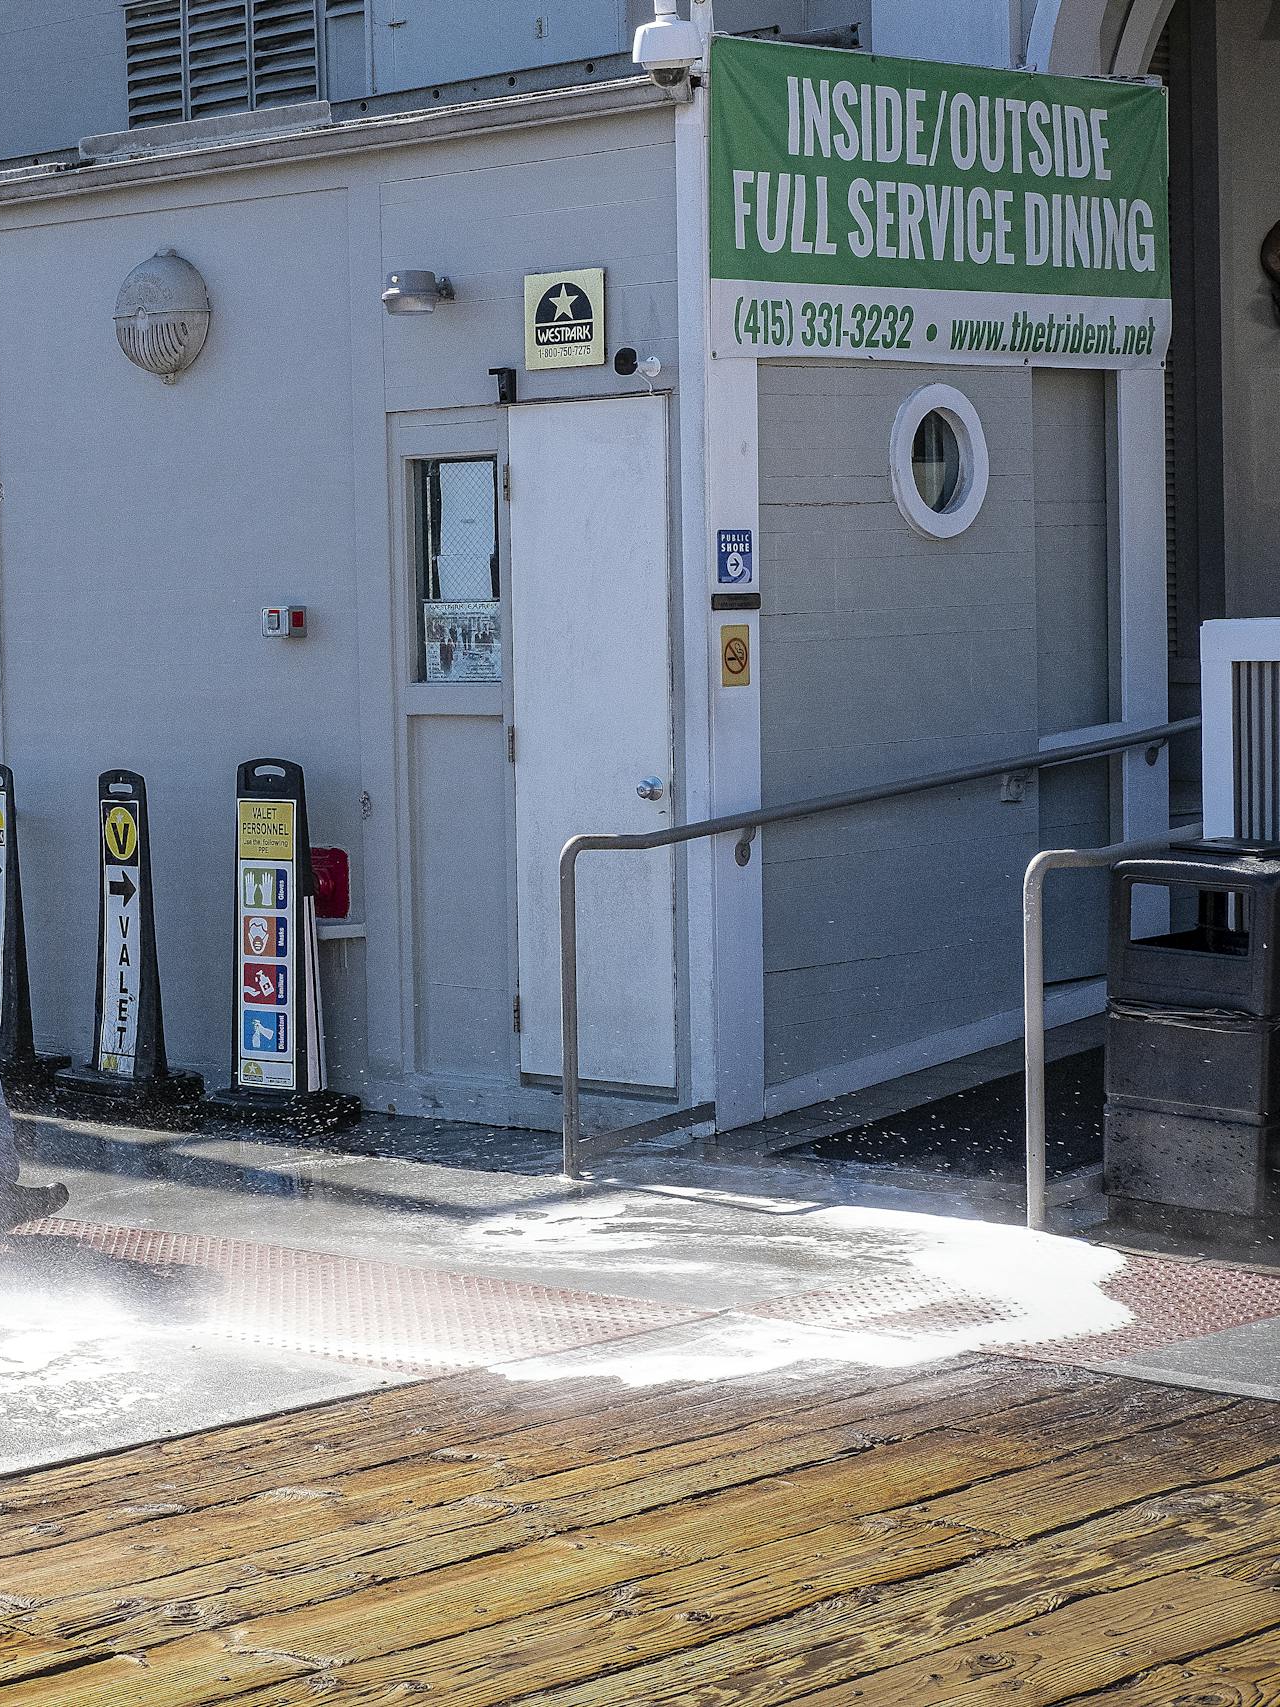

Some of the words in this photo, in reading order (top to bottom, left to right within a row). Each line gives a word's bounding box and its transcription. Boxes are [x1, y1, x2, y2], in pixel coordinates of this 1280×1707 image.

[787, 76, 1111, 181] INSIDE/OUTSIDE
[732, 170, 837, 255] FULL
[847, 177, 1015, 265] SERVICE
[1025, 191, 1156, 273] DINING
[537, 325, 591, 343] WESTPARK
[734, 296, 794, 347] (415)
[801, 301, 914, 350] 331-3232
[949, 310, 1156, 356] www.thetrident.net
[538, 345, 591, 358] 1-800-750-7275
[721, 534, 749, 542] PUBLIC
[721, 543, 750, 552] SHORE
[253, 807, 277, 819] VALET
[242, 822, 289, 836] PERSONNEL
[111, 822, 130, 855] V
[117, 915, 131, 1050] VALET
